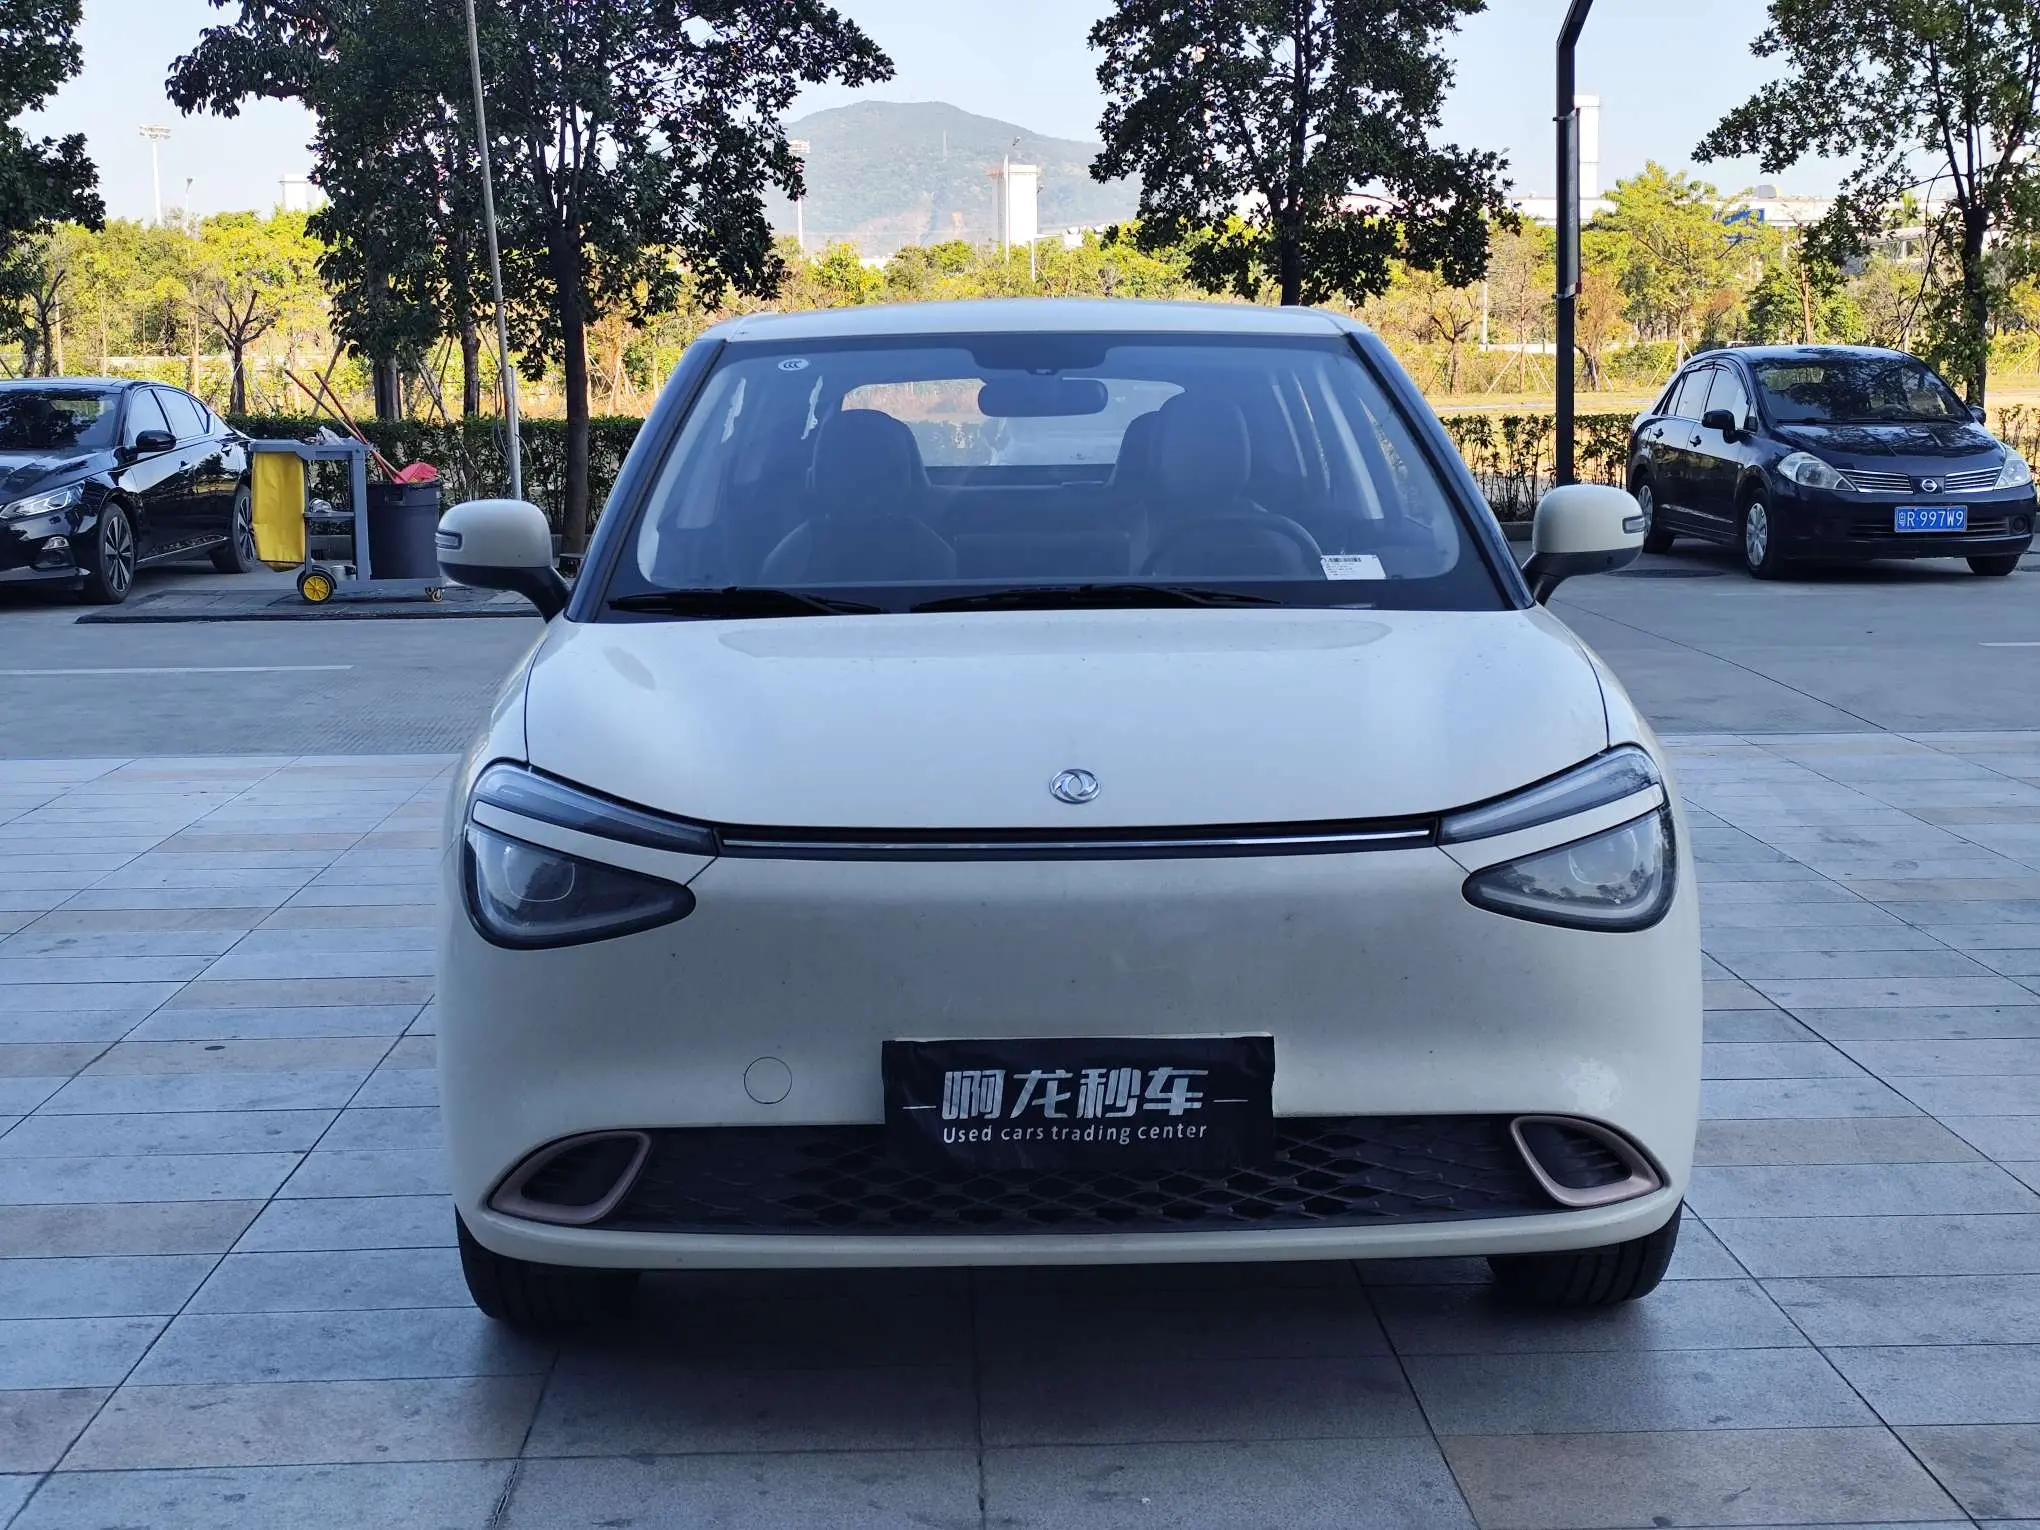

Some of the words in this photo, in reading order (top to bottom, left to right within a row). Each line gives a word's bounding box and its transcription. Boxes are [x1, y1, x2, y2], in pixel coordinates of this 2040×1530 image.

[943, 1124, 993, 1144] Used
[1000, 1127, 1044, 1141] cars
[1050, 1124, 1132, 1145] trading
[1137, 1122, 1208, 1139] center
